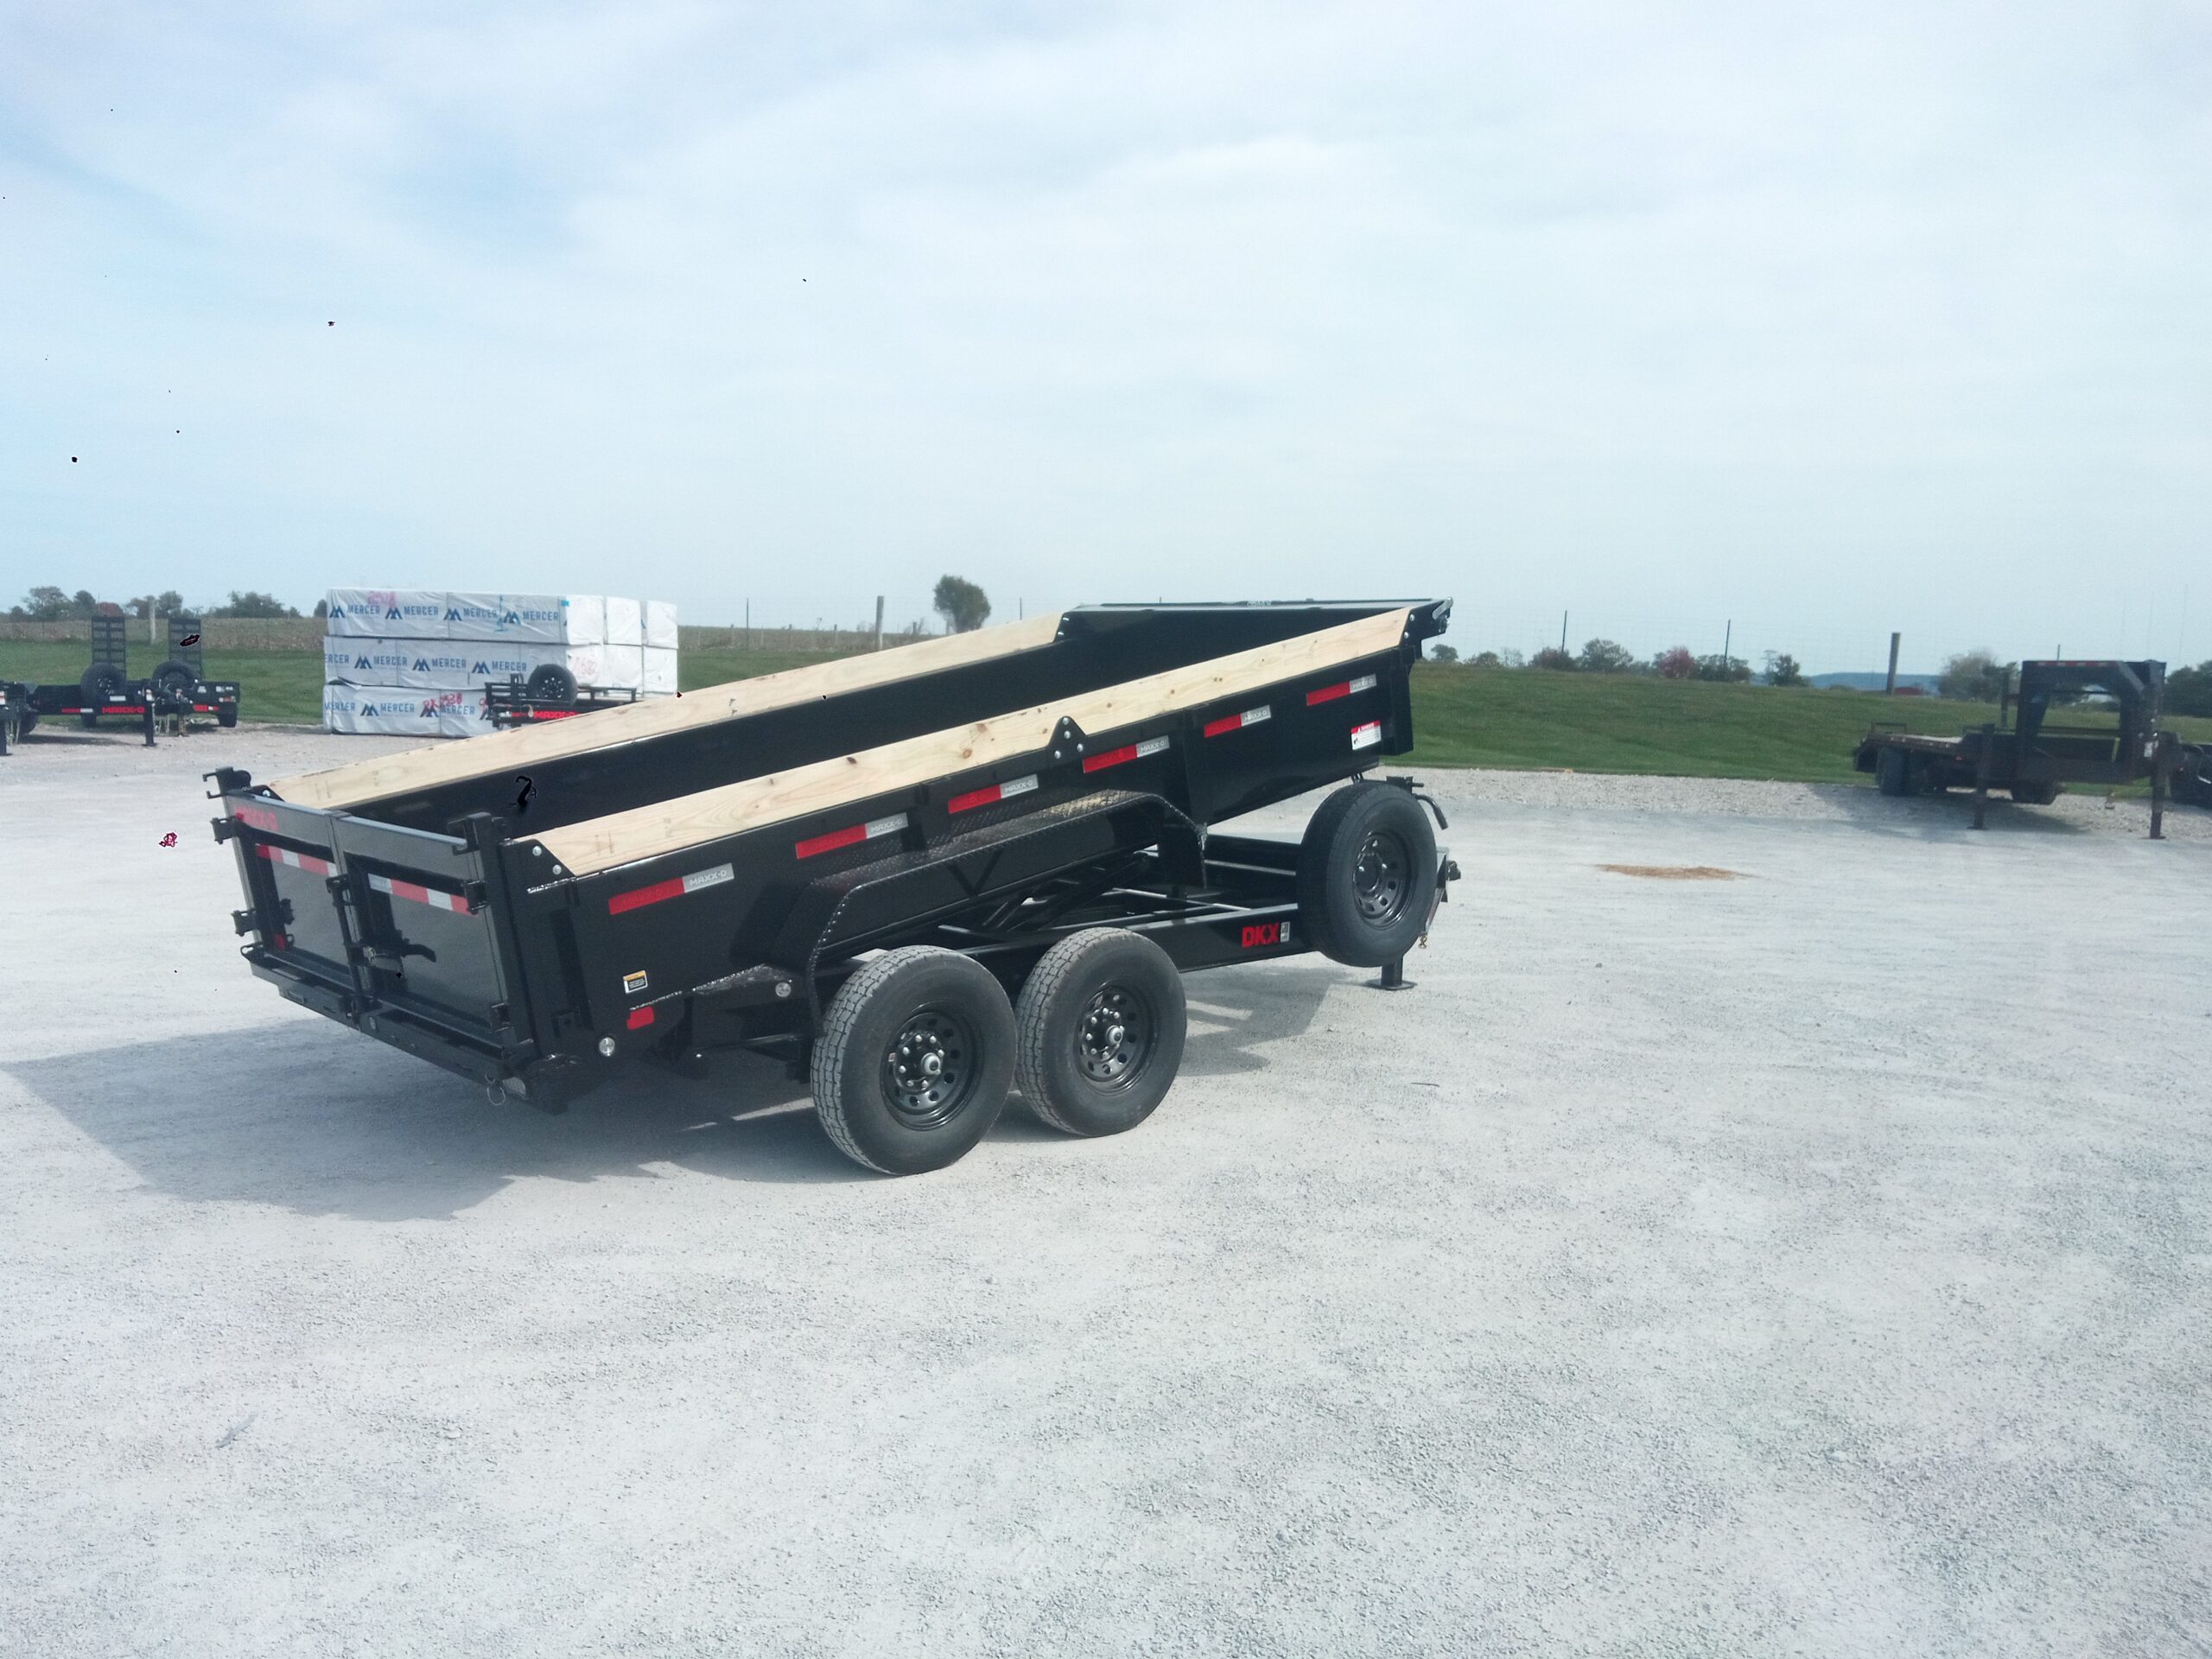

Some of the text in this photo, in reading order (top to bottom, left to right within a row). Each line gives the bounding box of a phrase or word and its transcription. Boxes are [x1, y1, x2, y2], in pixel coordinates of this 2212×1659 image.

[347, 604, 380, 615] MERCER
[404, 606, 439, 616] MERCER
[463, 607, 499, 619] MERCER
[522, 610, 560, 621] MERCER
[325, 653, 350, 664] ERCER
[373, 656, 408, 666] MERCER
[432, 658, 467, 669] MERCER
[491, 660, 527, 671] MERCER
[380, 702, 415, 713] MERCER
[689, 869, 728, 887] MAXX-D
[1242, 922, 1280, 948] DKX
